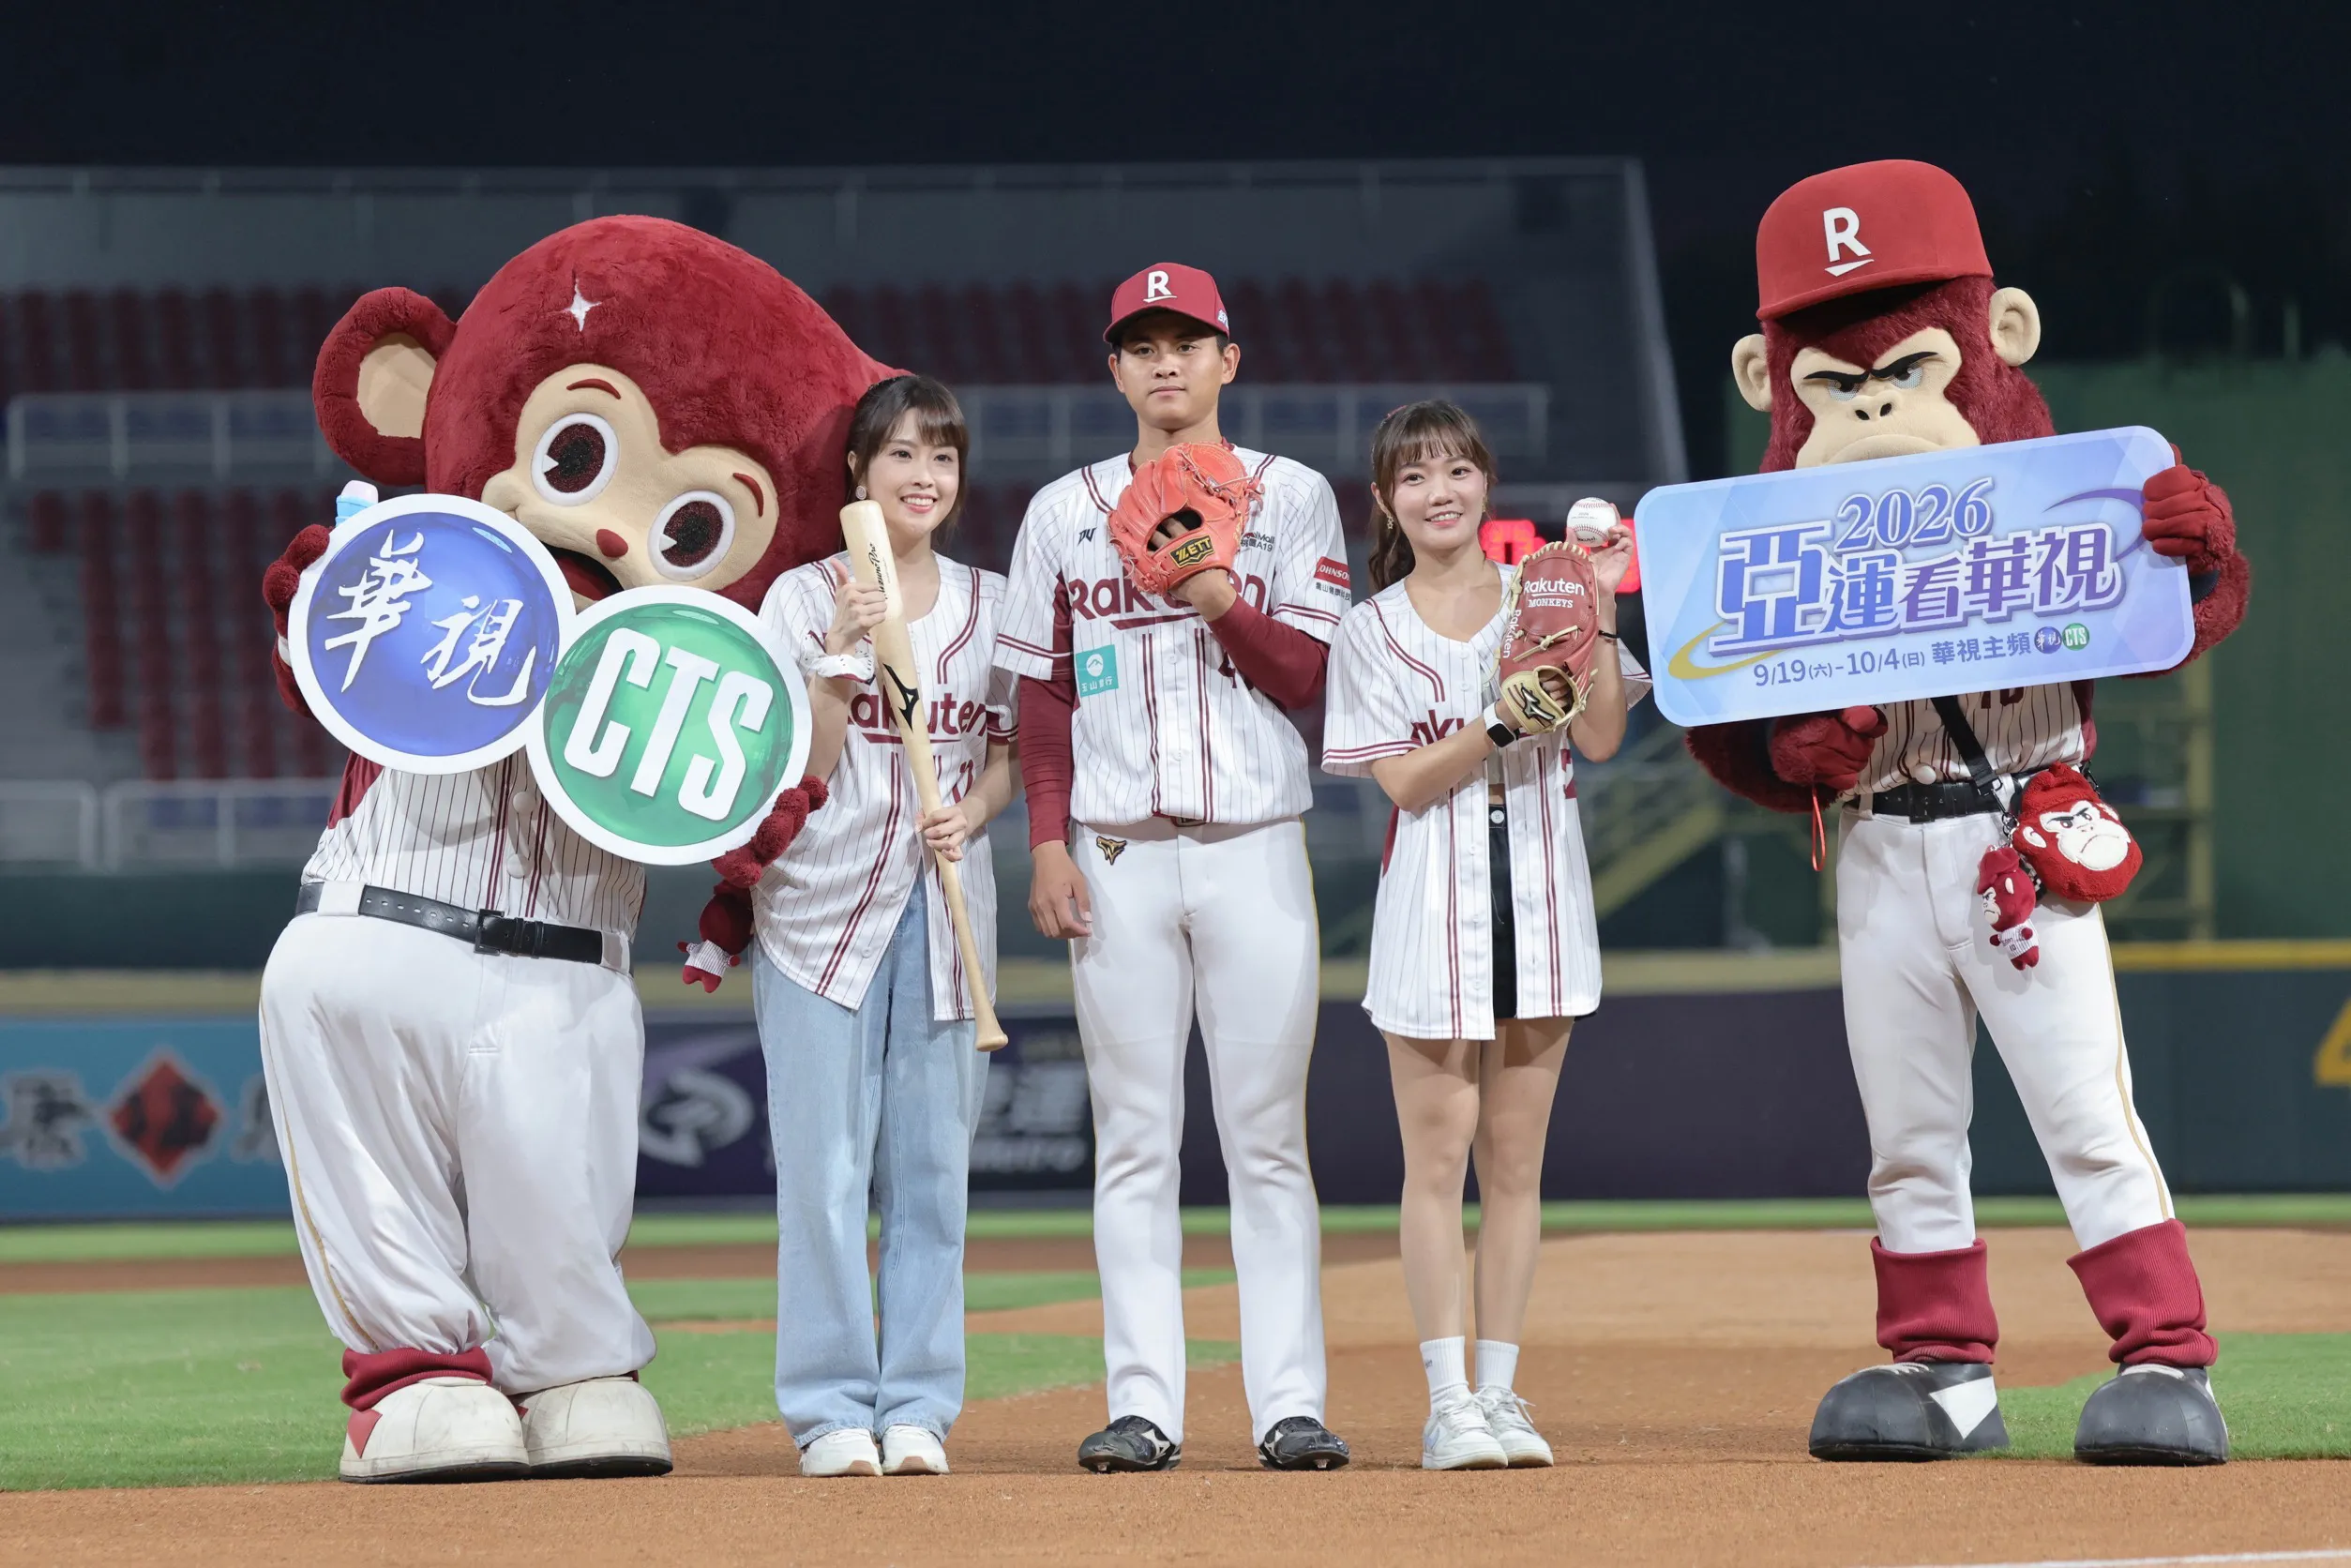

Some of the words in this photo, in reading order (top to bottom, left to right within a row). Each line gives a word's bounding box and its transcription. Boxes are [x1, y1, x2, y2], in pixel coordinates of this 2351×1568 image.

[1823, 206, 1872, 263] R
[1147, 270, 1172, 299] R
[1834, 477, 1993, 553] 2026
[1175, 536, 1213, 563] ZETT
[1069, 566, 1266, 621] Rakn
[1524, 578, 1585, 596] Rakuten
[1528, 597, 1574, 609] MONKEYS
[1711, 522, 2123, 651] 亞運看華視
[324, 529, 537, 707] 華視
[1932, 631, 2032, 665] 華視主頻
[2065, 626, 2087, 647] CTS
[564, 627, 774, 822] CTS
[848, 685, 987, 736] akten
